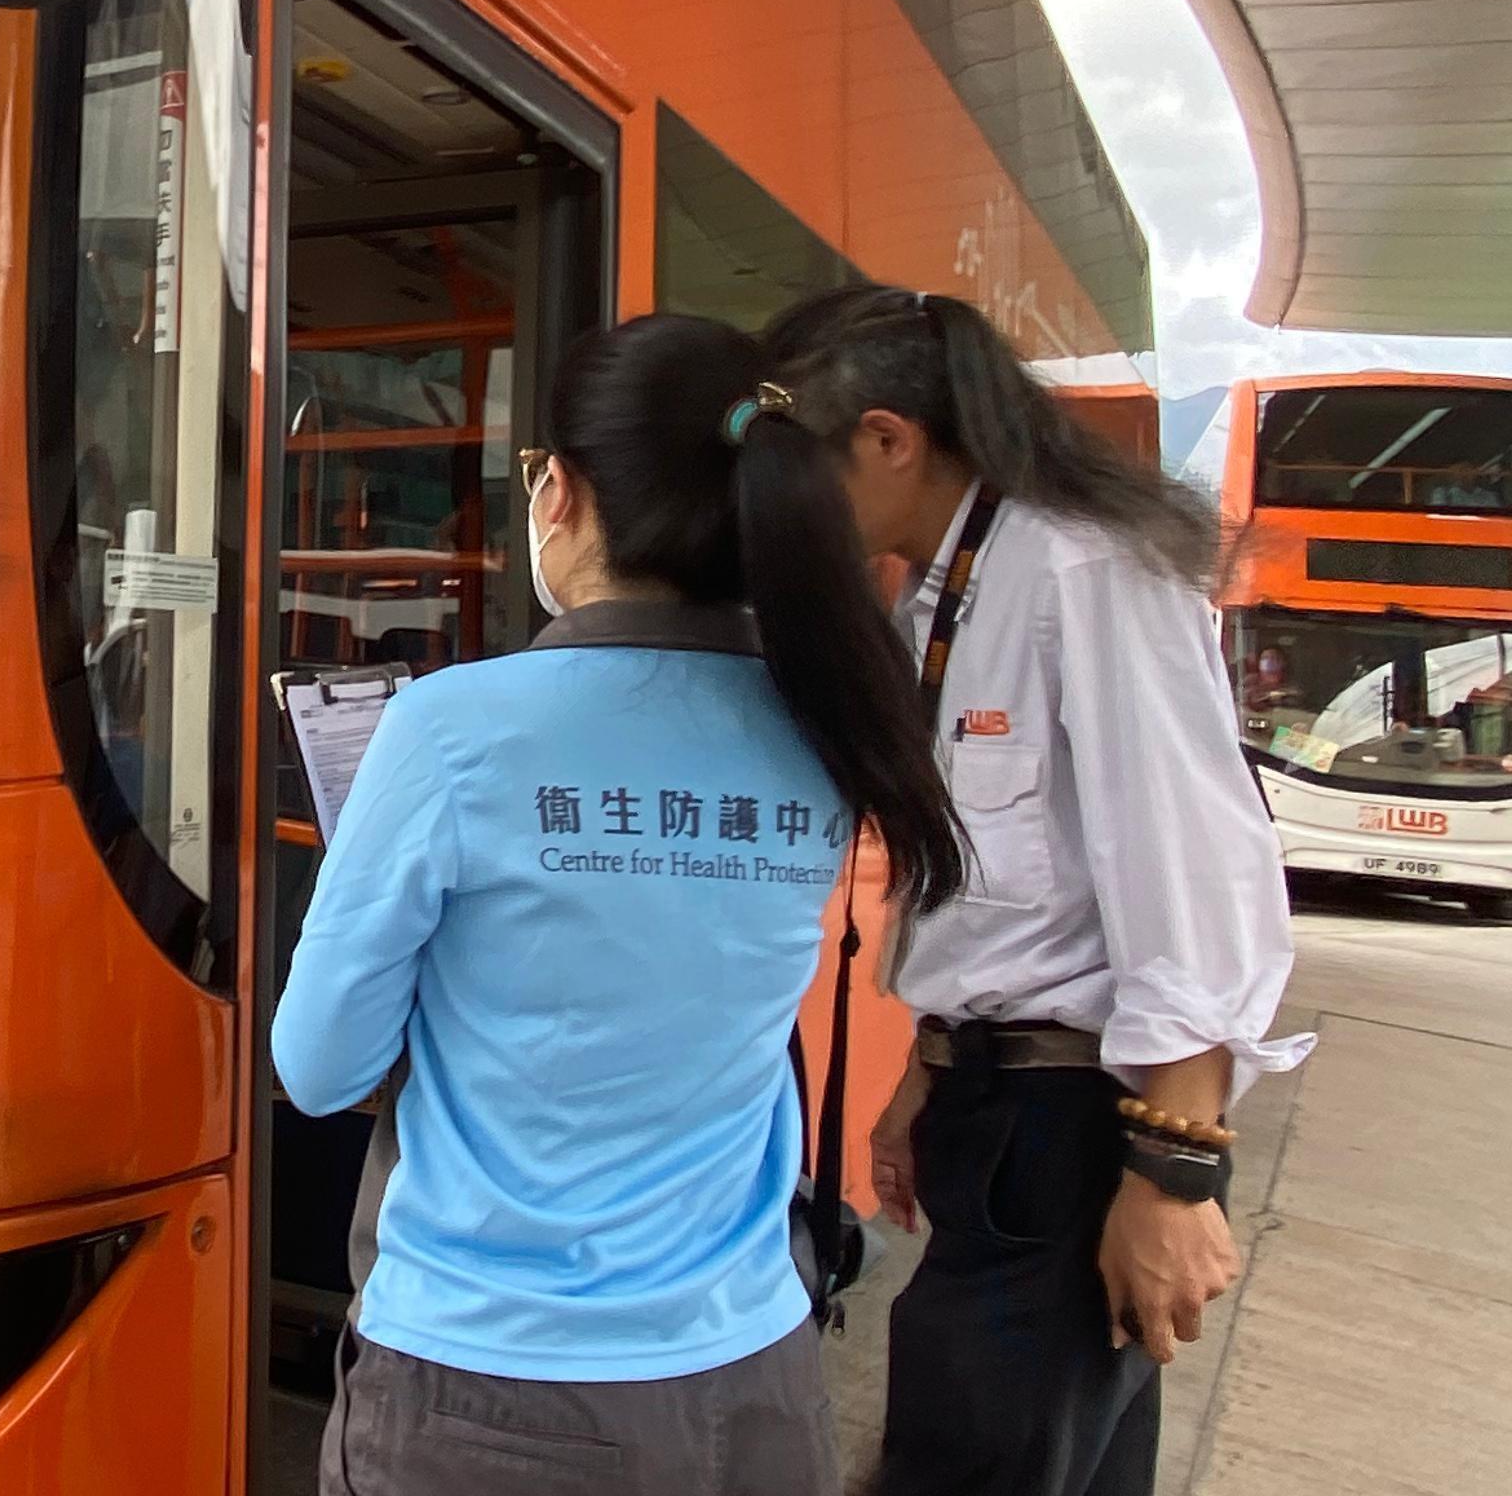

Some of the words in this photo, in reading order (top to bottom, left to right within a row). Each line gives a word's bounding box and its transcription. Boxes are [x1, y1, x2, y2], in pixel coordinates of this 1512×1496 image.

[1387, 808, 1448, 836] LWB
[539, 847, 624, 873] Centre
[630, 847, 665, 875] for
[670, 851, 747, 881] Health
[1363, 857, 1387, 869] UF
[1395, 860, 1439, 875] 4989
